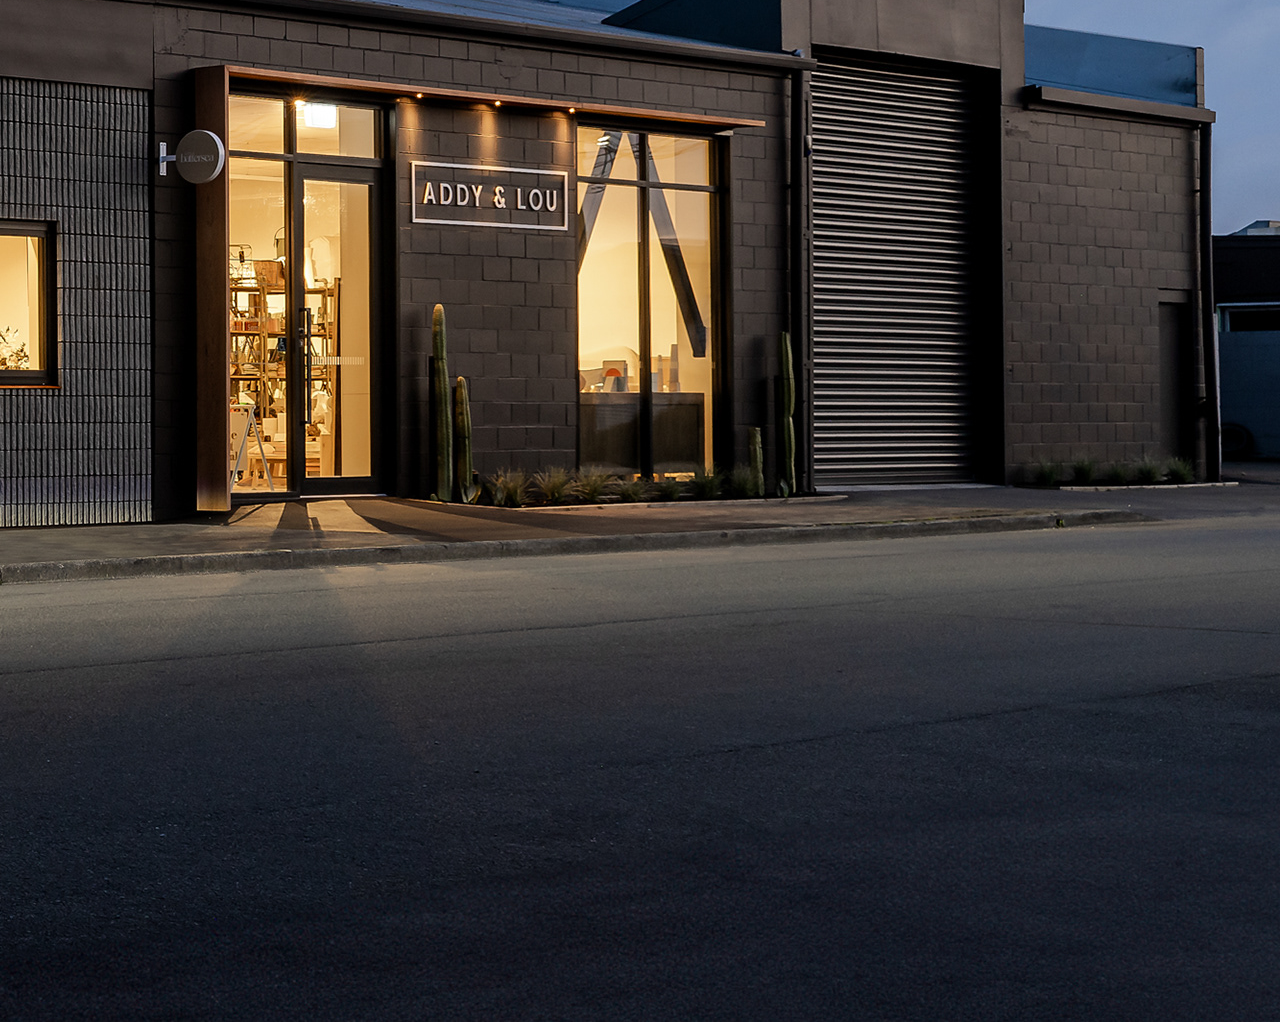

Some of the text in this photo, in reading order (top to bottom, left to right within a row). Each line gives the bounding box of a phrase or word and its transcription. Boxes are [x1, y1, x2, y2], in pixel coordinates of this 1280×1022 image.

[422, 182, 557, 212] ADDY & LOU
